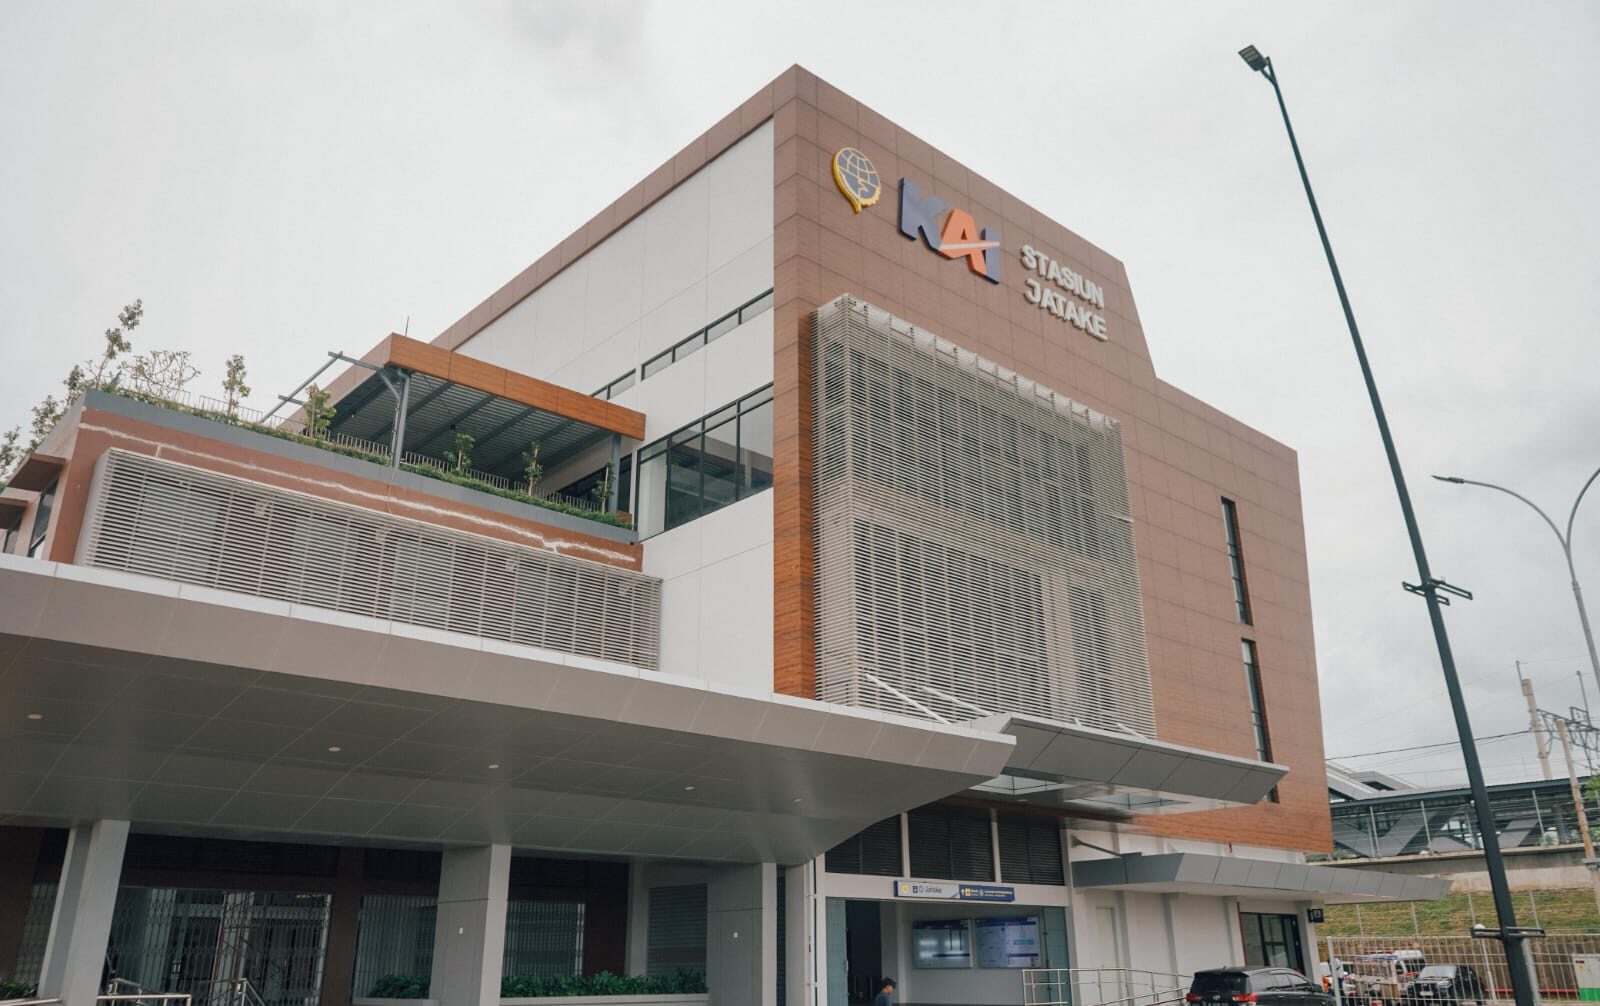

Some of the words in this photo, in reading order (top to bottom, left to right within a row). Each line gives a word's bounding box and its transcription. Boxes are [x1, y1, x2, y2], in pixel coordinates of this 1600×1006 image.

[898, 177, 1000, 284] KAI
[1021, 244, 1104, 309] STASIUN
[1024, 278, 1108, 342] JATAKE
